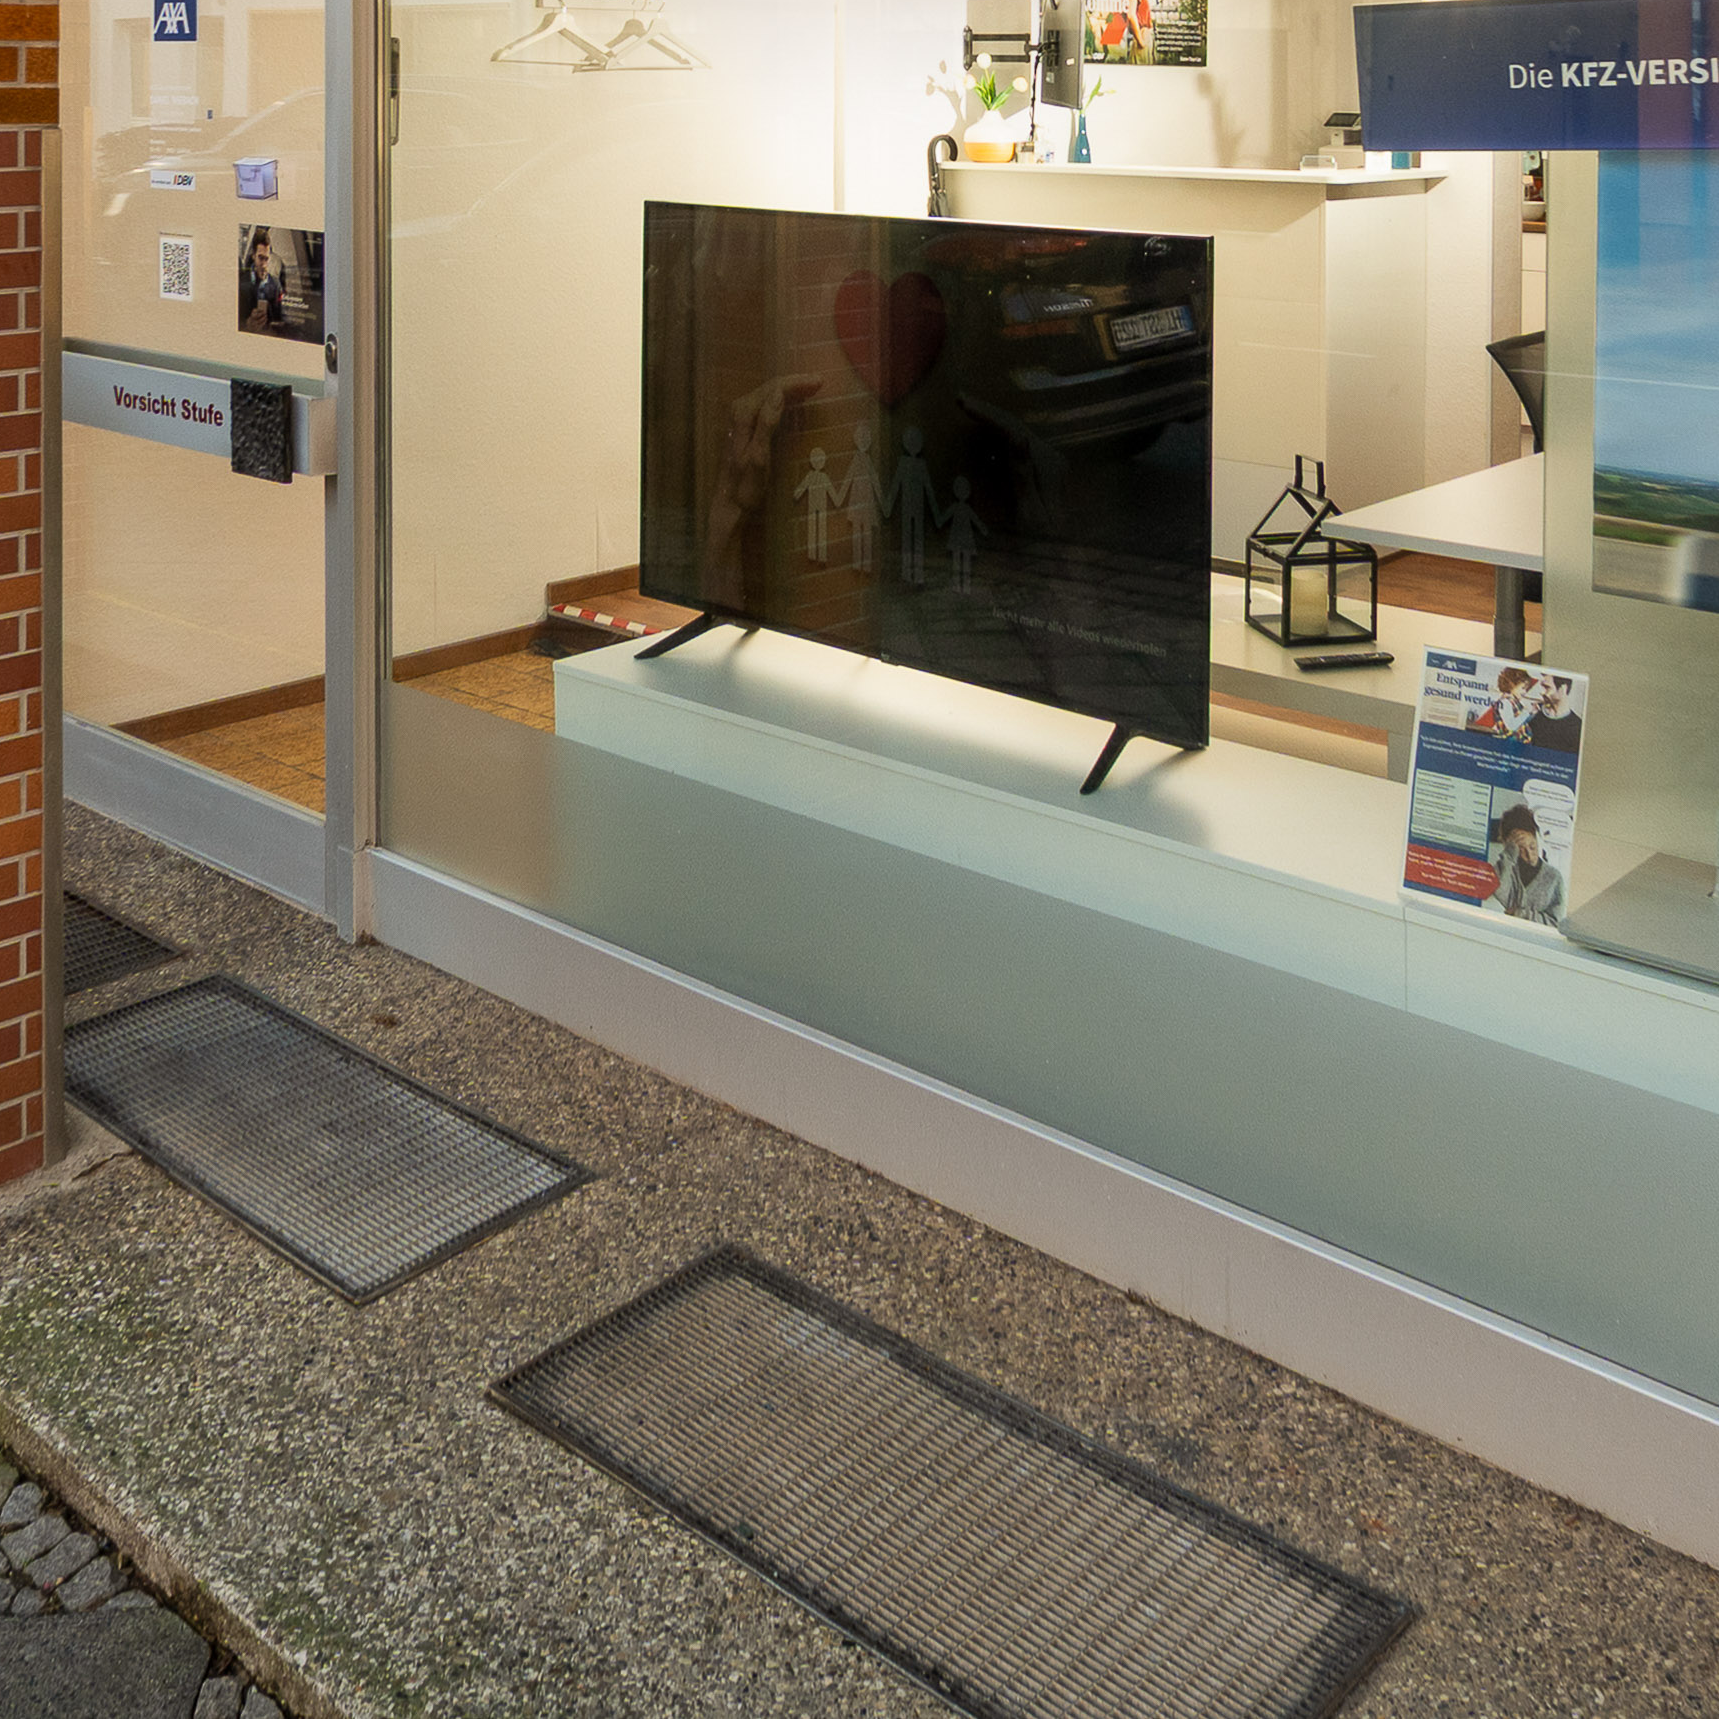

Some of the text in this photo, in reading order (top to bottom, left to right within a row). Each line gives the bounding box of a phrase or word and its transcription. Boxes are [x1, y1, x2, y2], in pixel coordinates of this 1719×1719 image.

[153, 1, 191, 34] AXA
[1507, 62, 1554, 90] Die
[113, 385, 224, 427] Vorsicht Stufe
[1436, 672, 1490, 692] Entspannt
[1423, 685, 1504, 710] gesund werden
